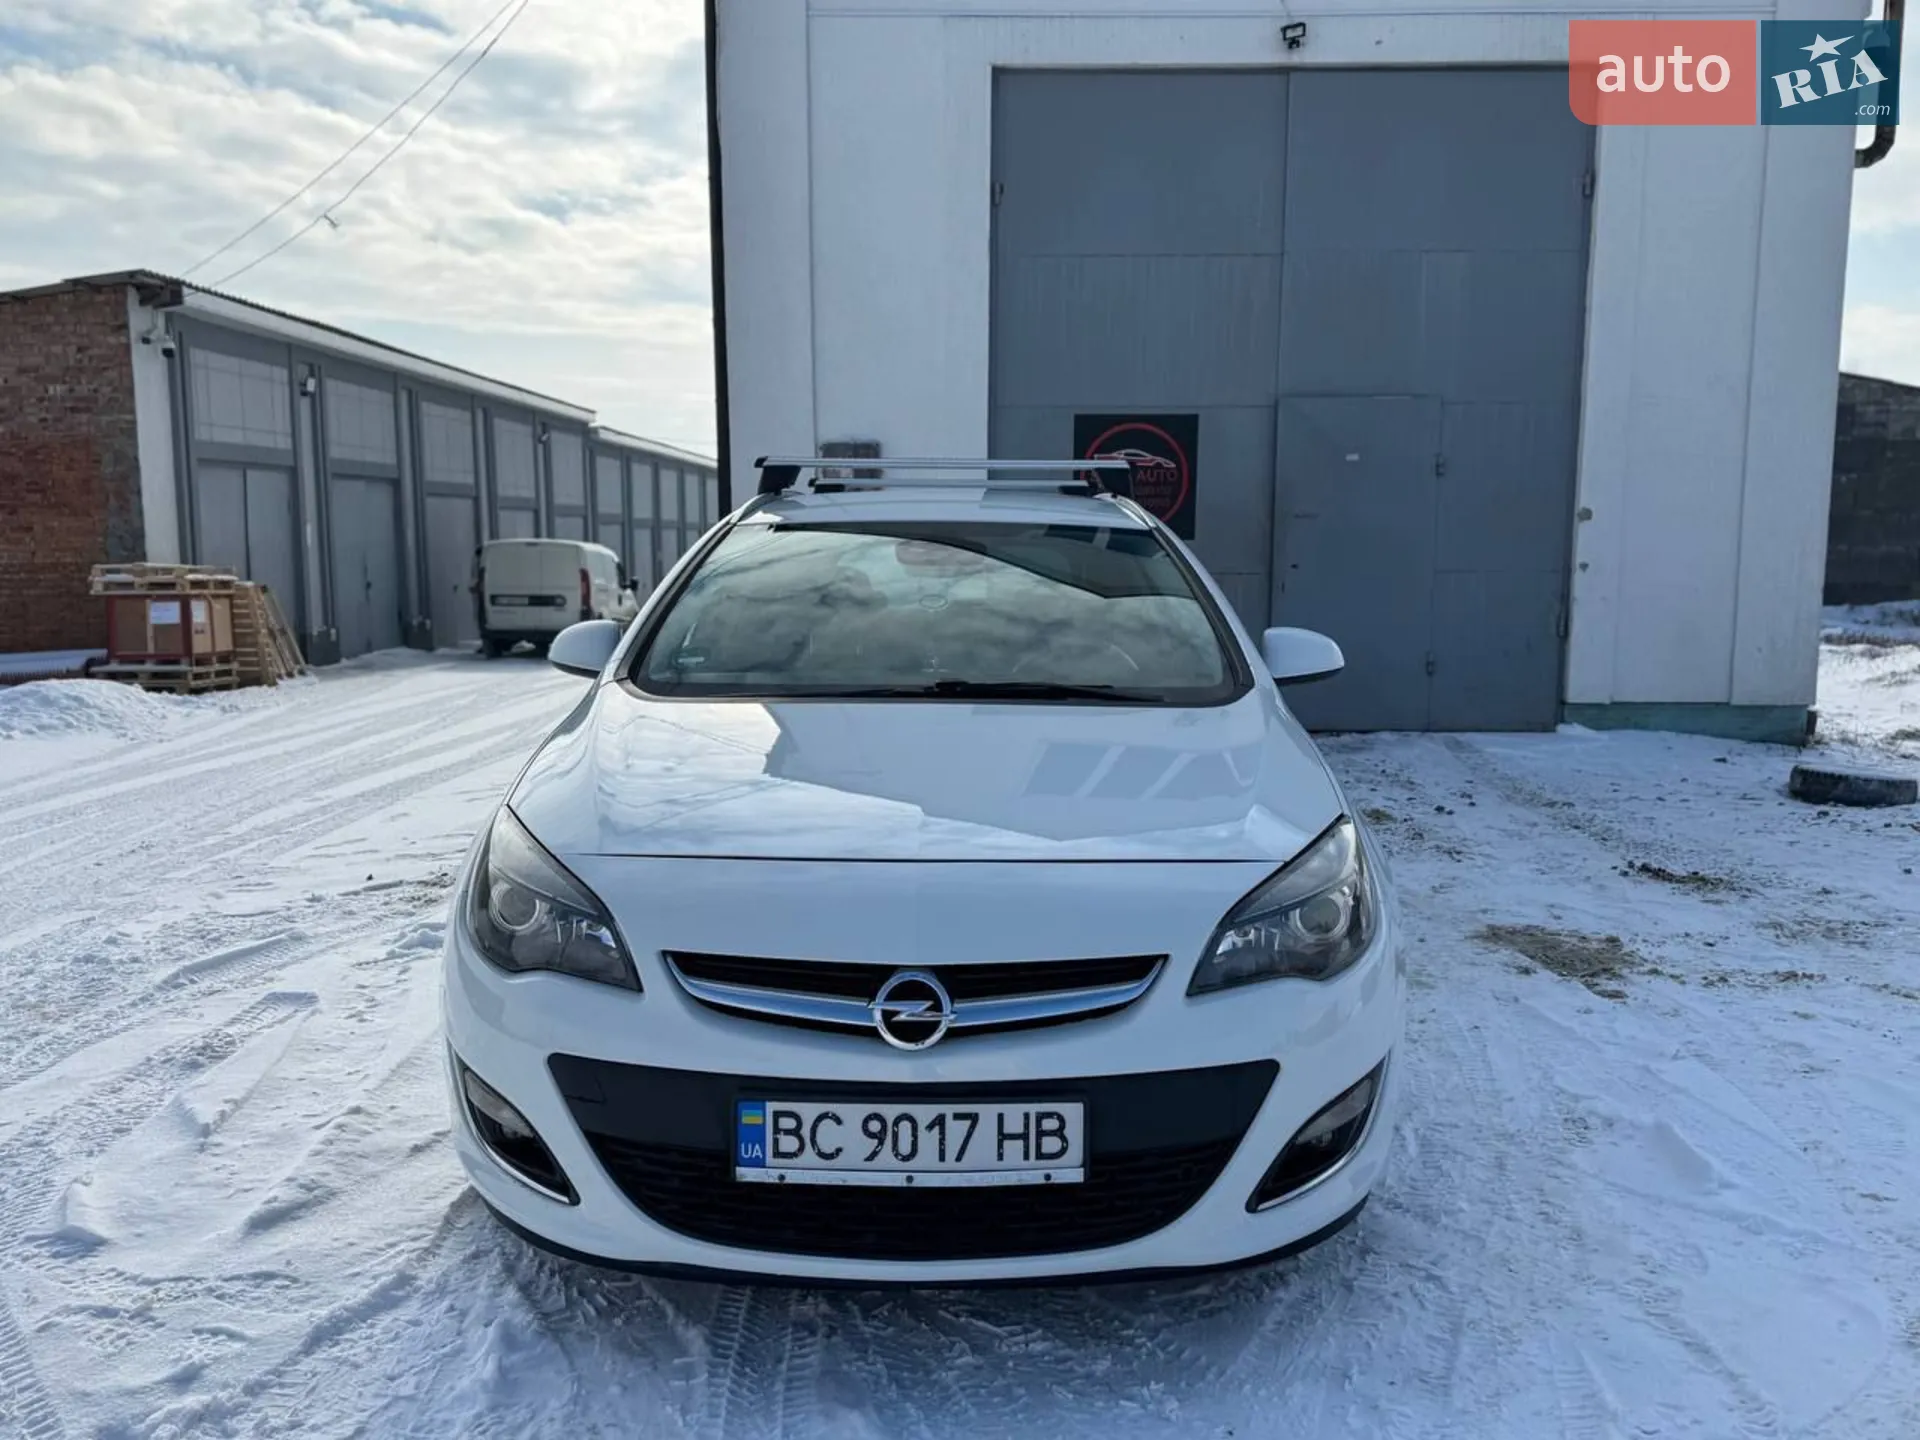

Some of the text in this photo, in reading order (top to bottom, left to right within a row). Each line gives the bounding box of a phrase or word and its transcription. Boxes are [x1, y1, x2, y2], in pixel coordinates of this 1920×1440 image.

[741, 1143, 763, 1159] UA
[772, 1110, 1070, 1163] BC 9017 HB
